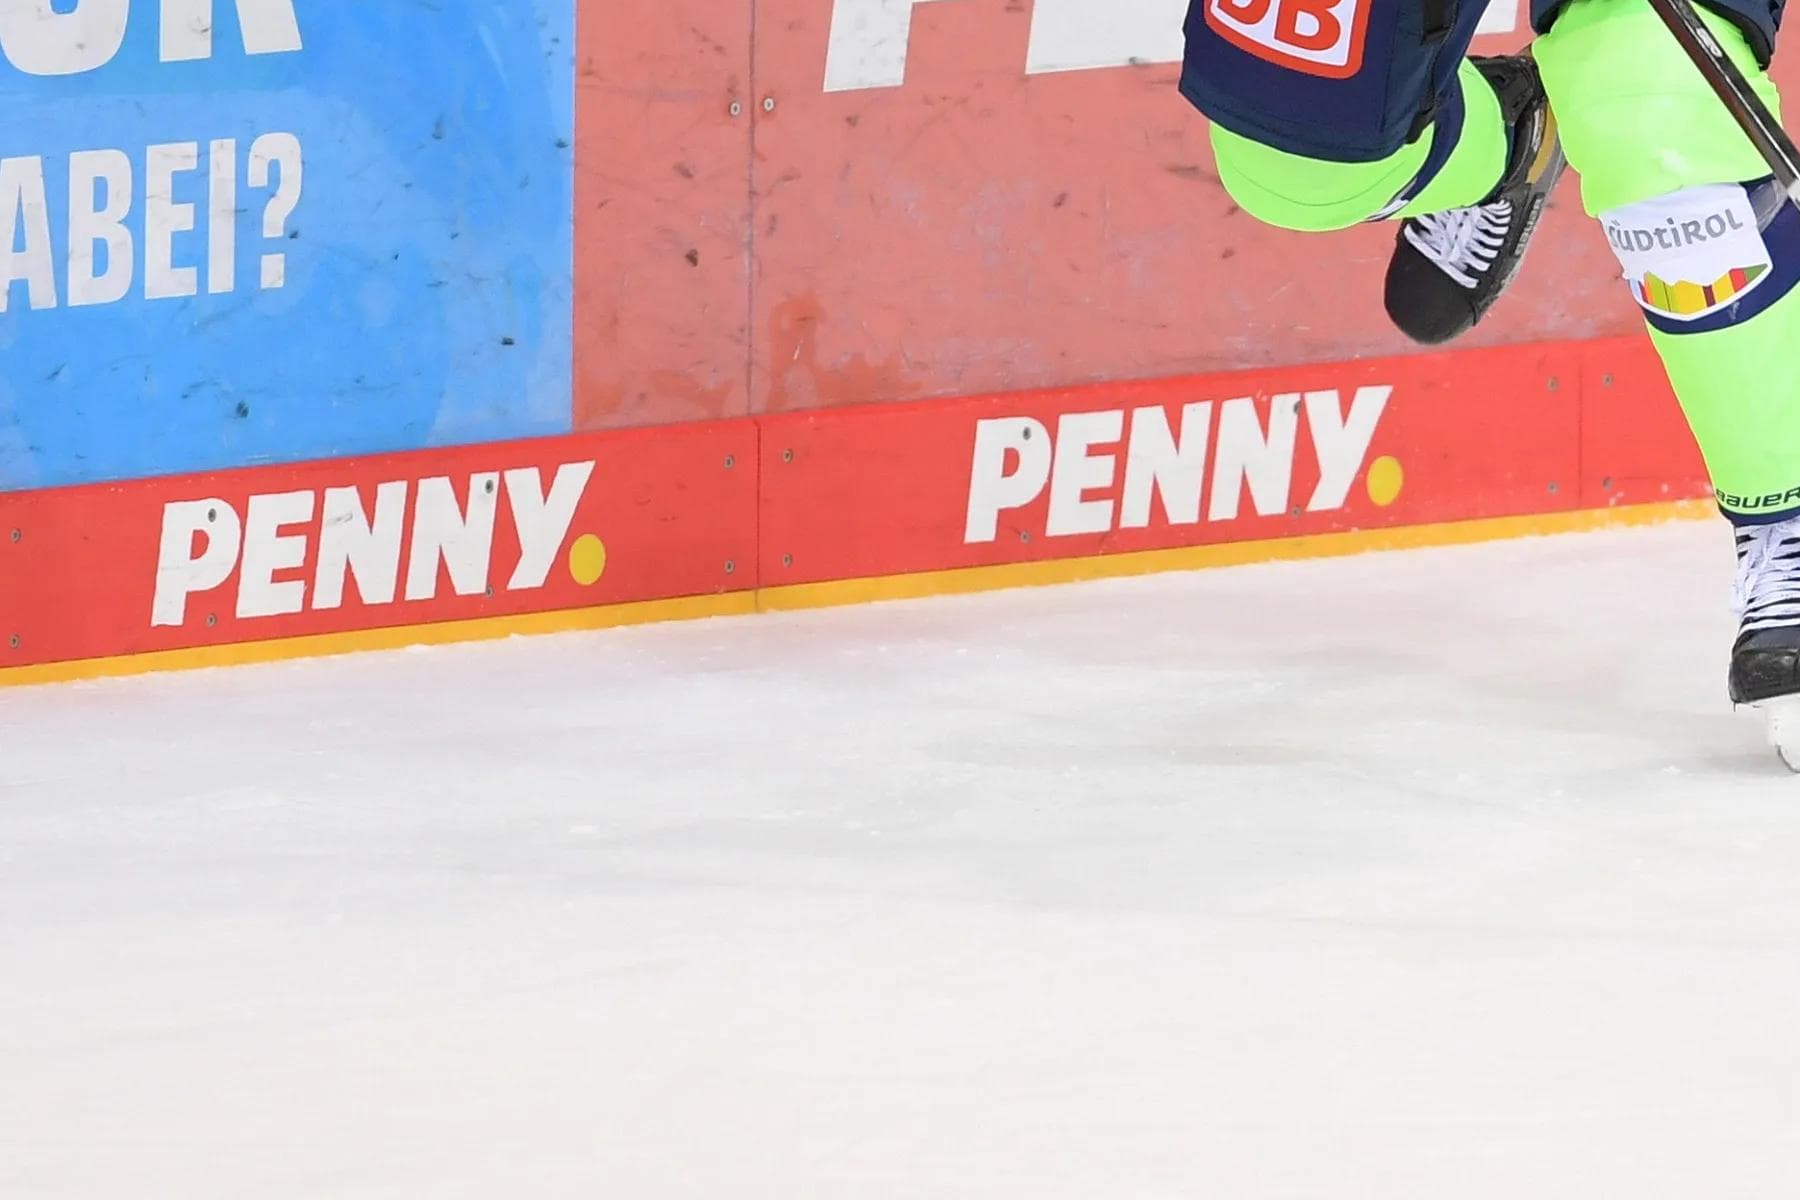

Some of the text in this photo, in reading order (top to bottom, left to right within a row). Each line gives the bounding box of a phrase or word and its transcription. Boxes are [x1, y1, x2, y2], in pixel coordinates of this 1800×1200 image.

[0, 131, 303, 314] ABEI?
[150, 460, 596, 627] PENNY
[963, 384, 1394, 544] PENNY
